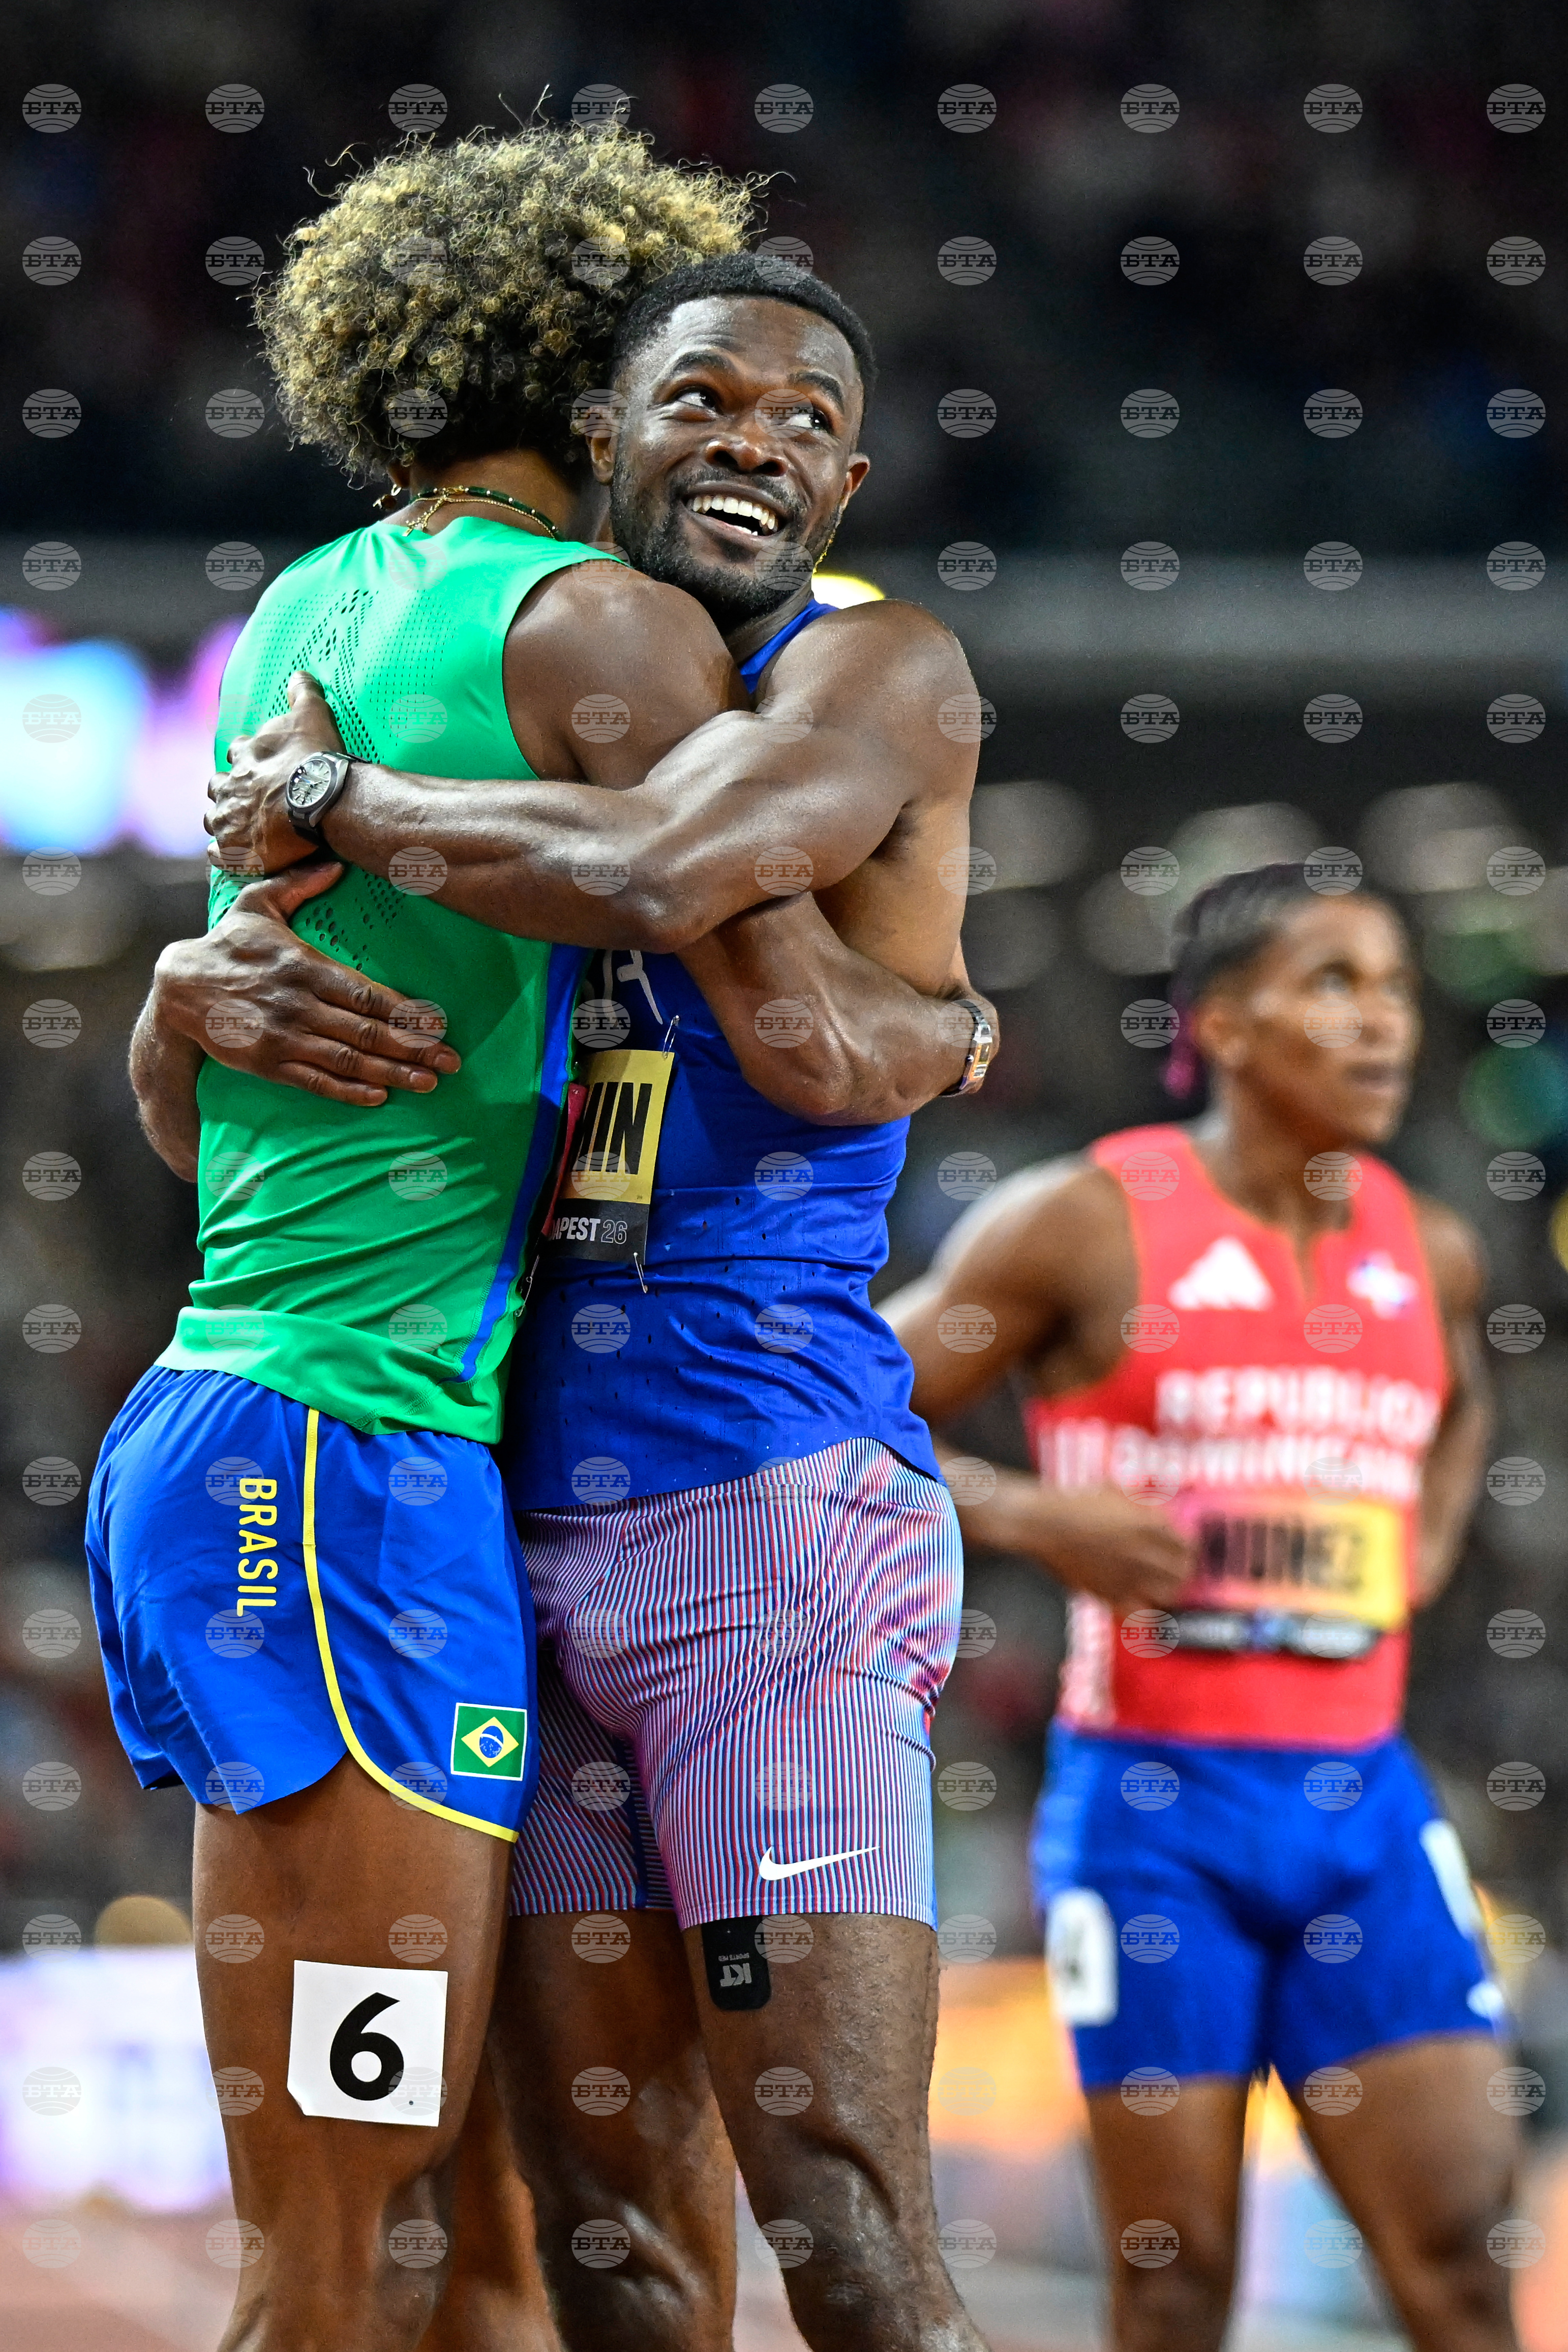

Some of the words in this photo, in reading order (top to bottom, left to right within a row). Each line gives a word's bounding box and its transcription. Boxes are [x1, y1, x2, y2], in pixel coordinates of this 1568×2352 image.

[552, 1217, 601, 1241] APEST
[601, 1219, 627, 1244] 26
[237, 1477, 278, 1617] BRASIL
[720, 1963, 752, 1987] KT
[329, 1992, 405, 2101] 6
